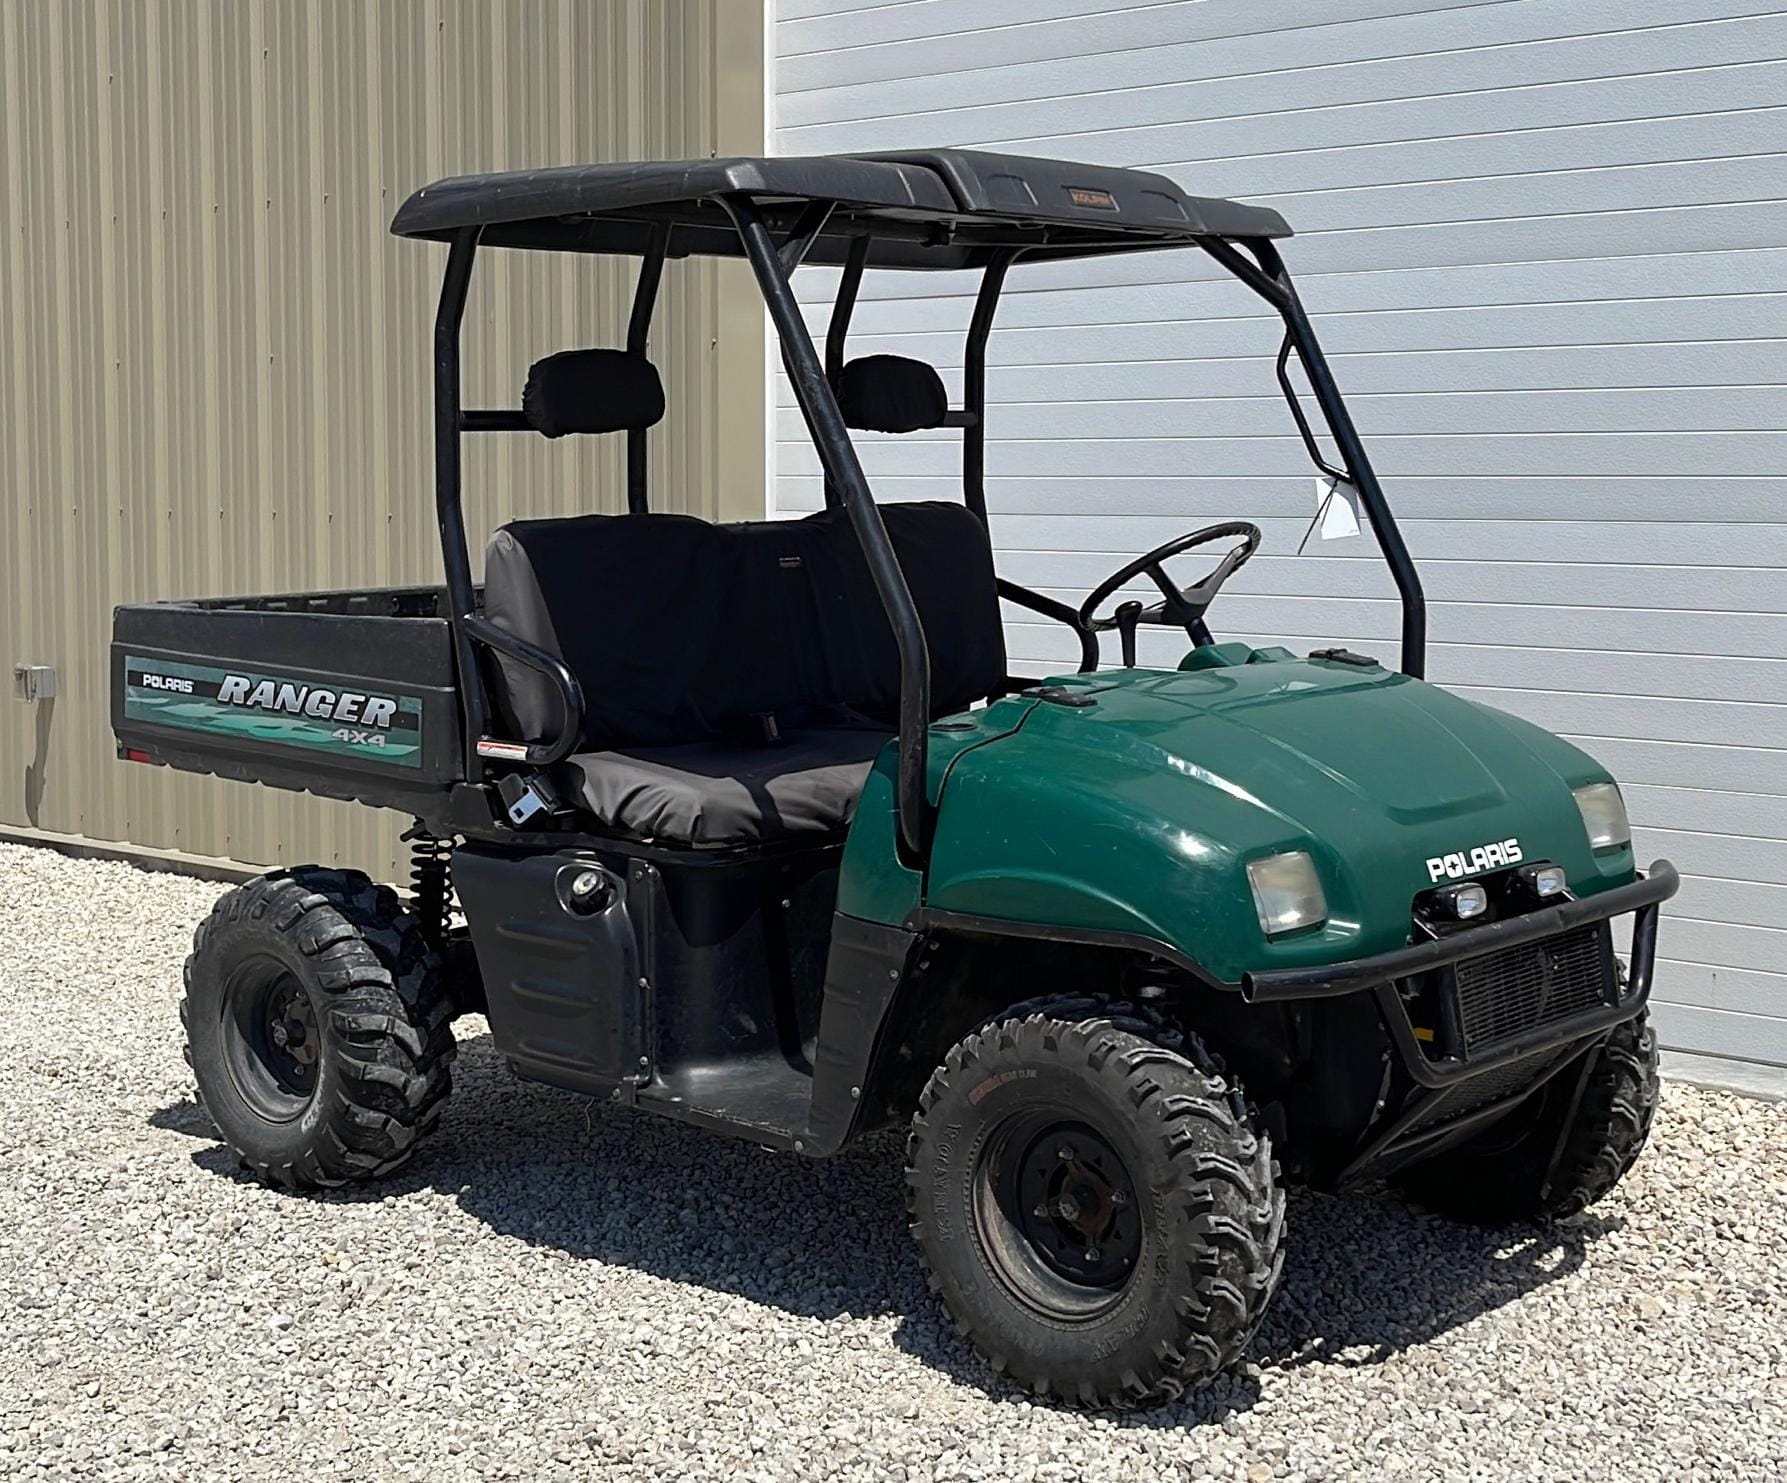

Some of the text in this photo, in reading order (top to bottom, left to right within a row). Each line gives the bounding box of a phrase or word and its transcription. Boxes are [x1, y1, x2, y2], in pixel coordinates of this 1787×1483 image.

[143, 674, 194, 693] POLARIS
[217, 674, 397, 728] RANGER
[332, 728, 386, 747] 4X4
[1426, 838, 1523, 882] POLARIS
